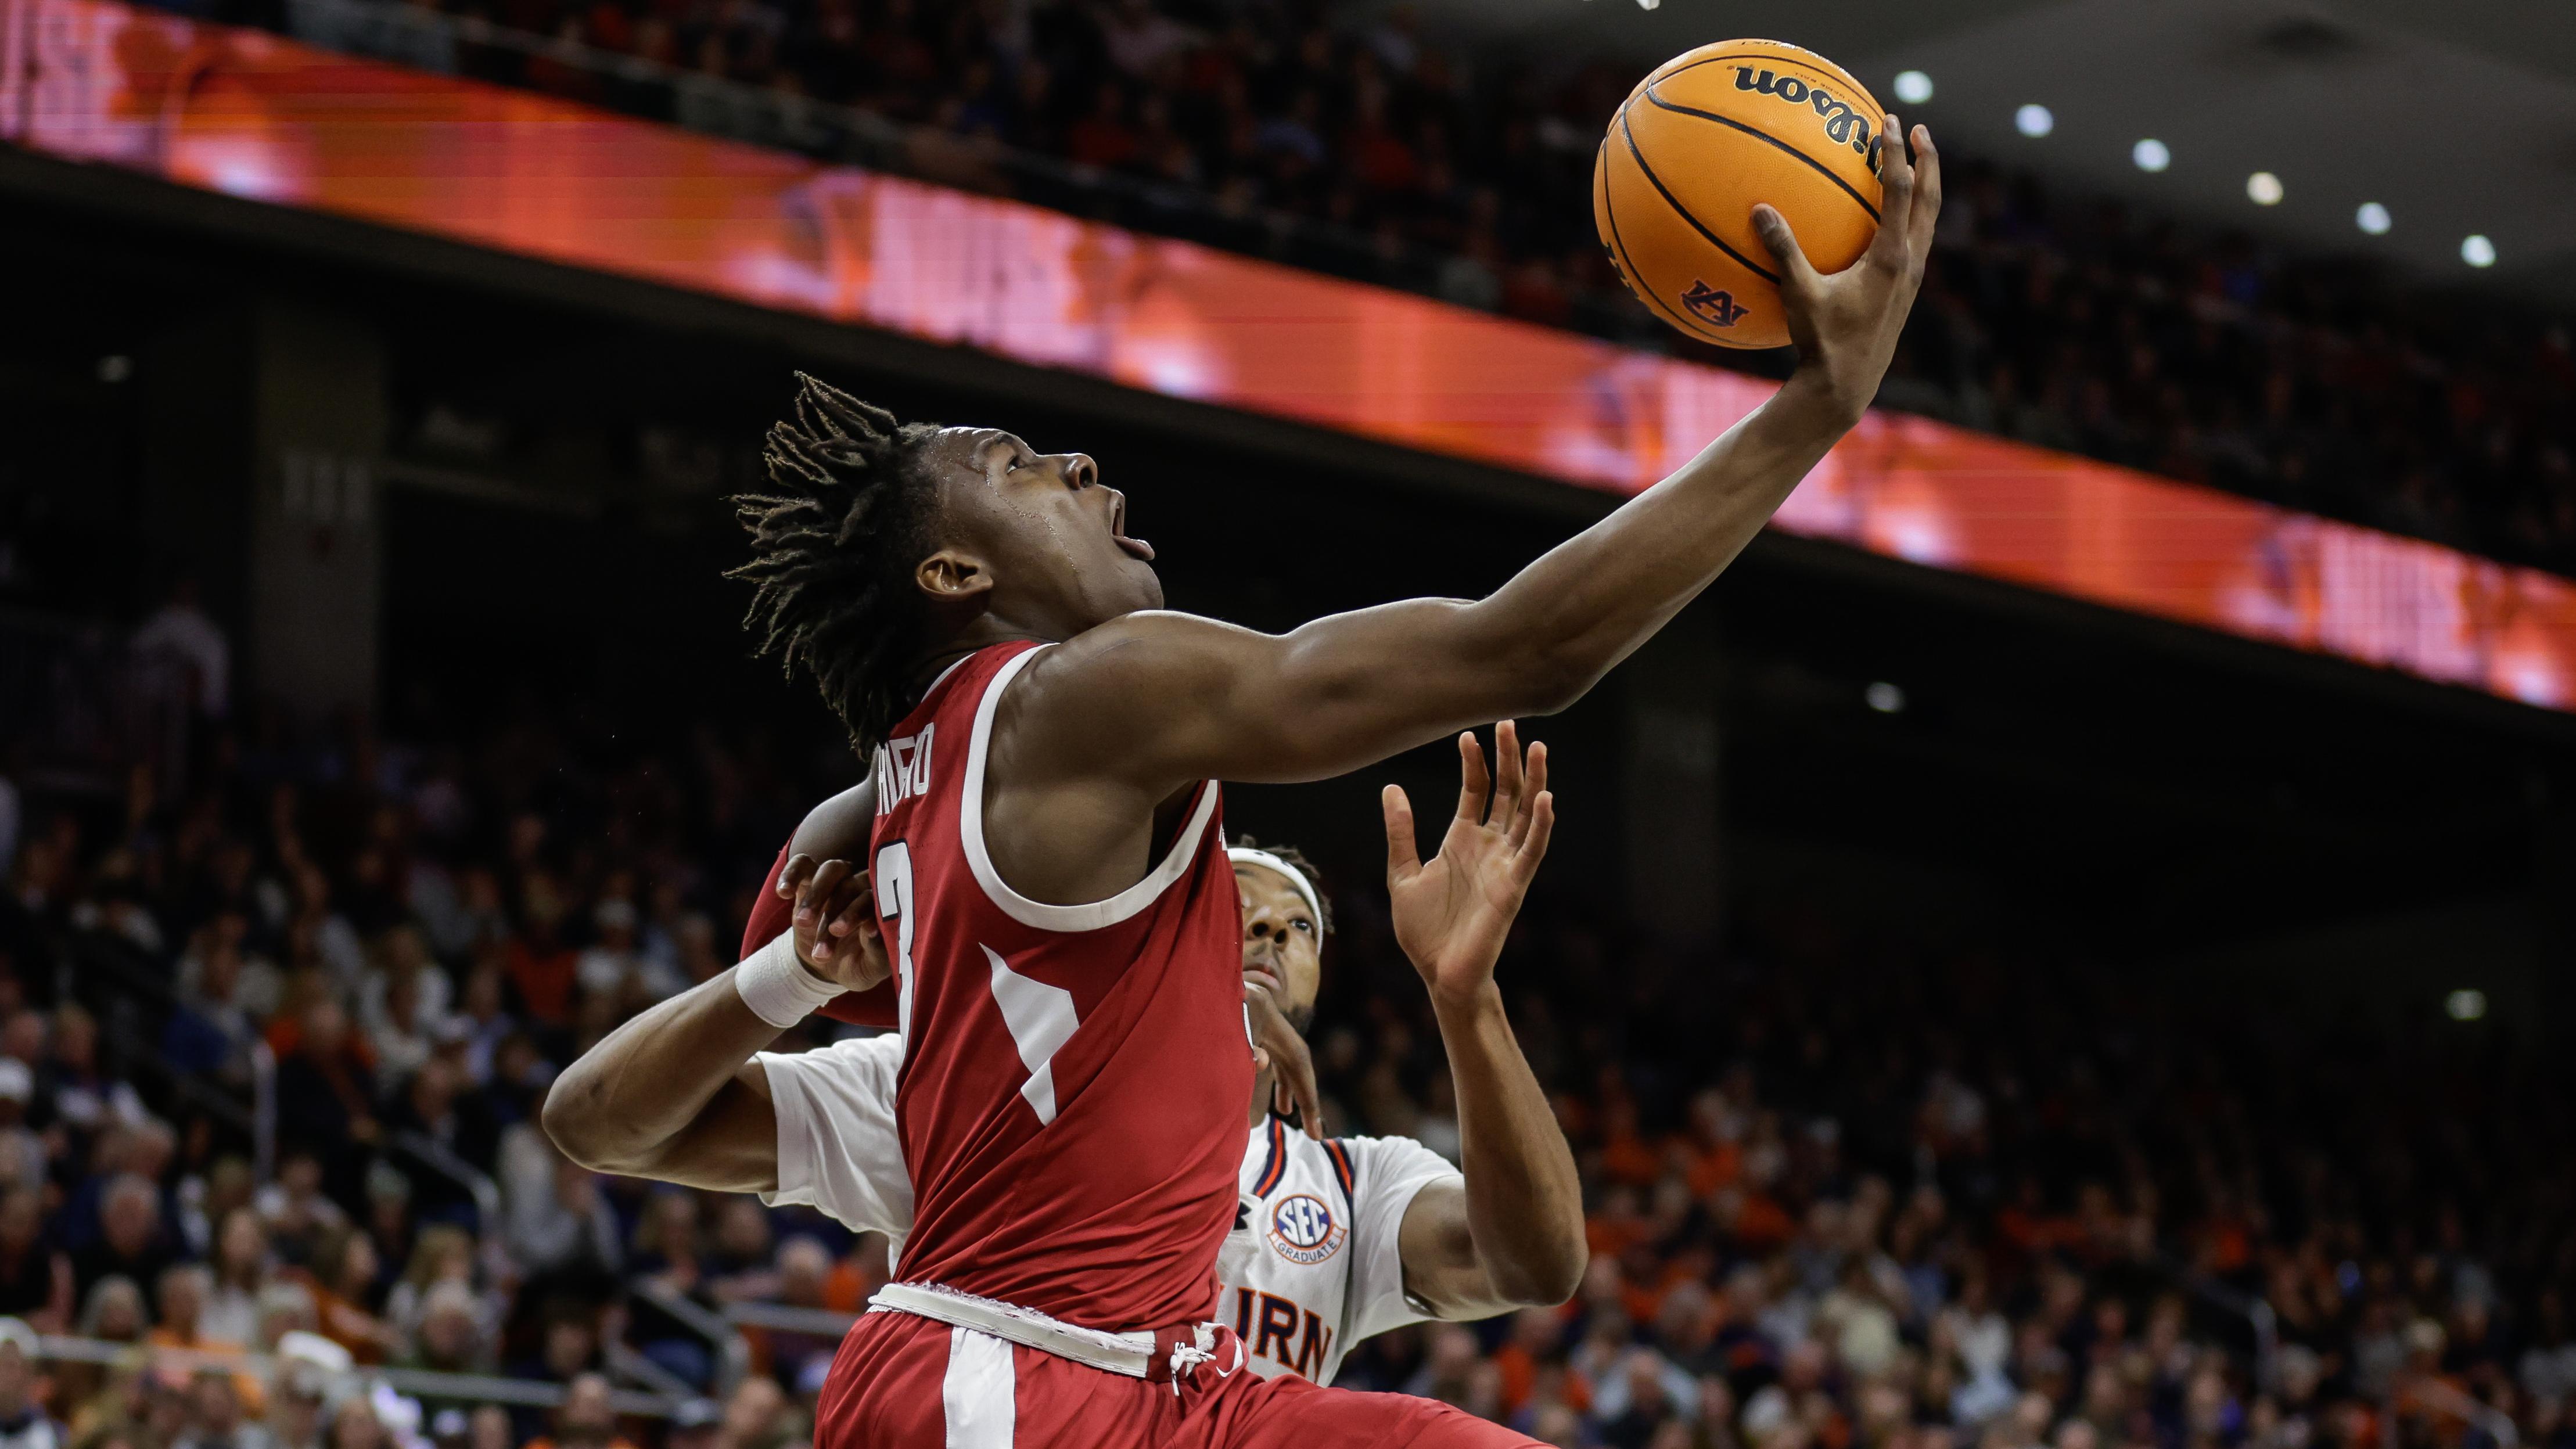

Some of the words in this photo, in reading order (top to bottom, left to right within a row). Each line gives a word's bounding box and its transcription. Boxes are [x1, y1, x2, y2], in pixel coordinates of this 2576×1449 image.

[876, 722, 935, 816] HIEO
[1277, 1197, 1328, 1247] SEC
[1278, 1239, 1338, 1262] GRADUATE
